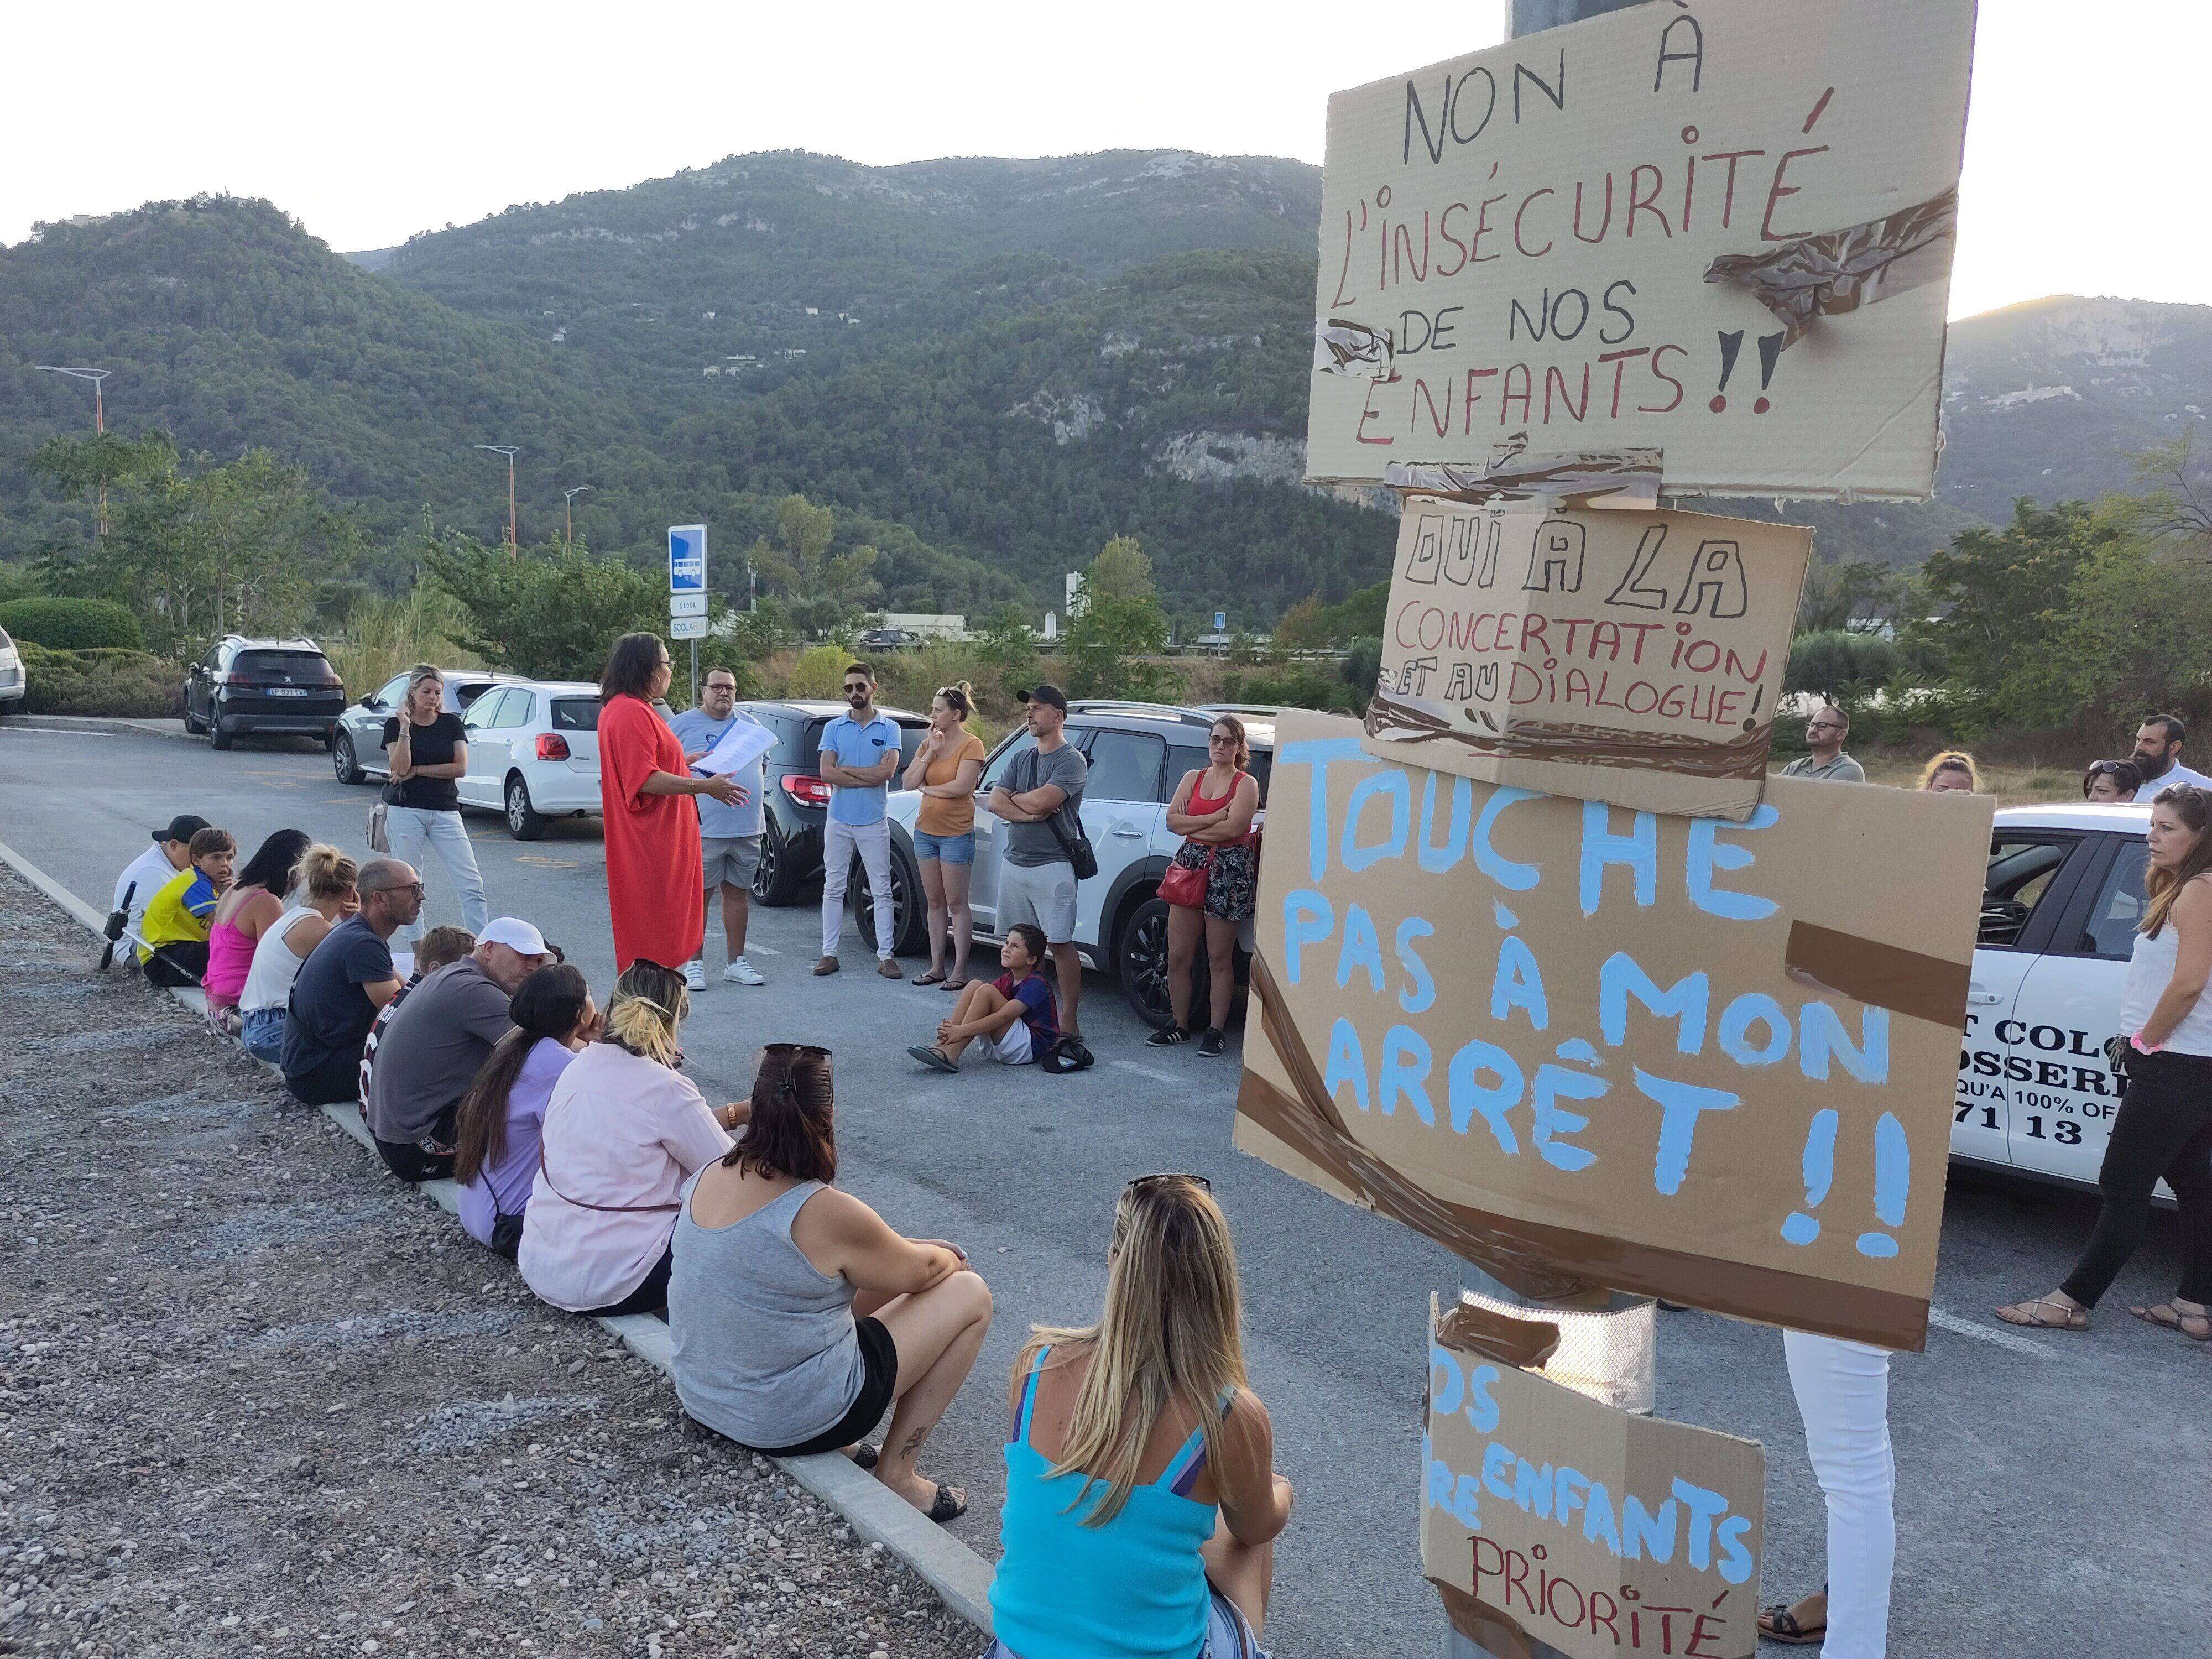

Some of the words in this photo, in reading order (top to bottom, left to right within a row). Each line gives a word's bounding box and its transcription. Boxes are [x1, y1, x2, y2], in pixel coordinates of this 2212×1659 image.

[1404, 48, 1565, 165] NON
[1654, 0, 1704, 93] À
[1394, 306, 1464, 355] DE
[1510, 280, 1637, 345] NOS
[1604, 523, 1748, 619] LA
[1397, 656, 1438, 697] ET
[1444, 662, 1499, 703] AU
[1280, 737, 1781, 921] TOUCHE
[1282, 889, 1436, 1014] PAS
[1490, 896, 1548, 1031] À
[1599, 951, 1889, 1085] MON
[1324, 1015, 1746, 1196] ARRÊT
[2014, 1090, 2074, 1114] 100%
[1481, 1441, 1752, 1584] ENFANTS
